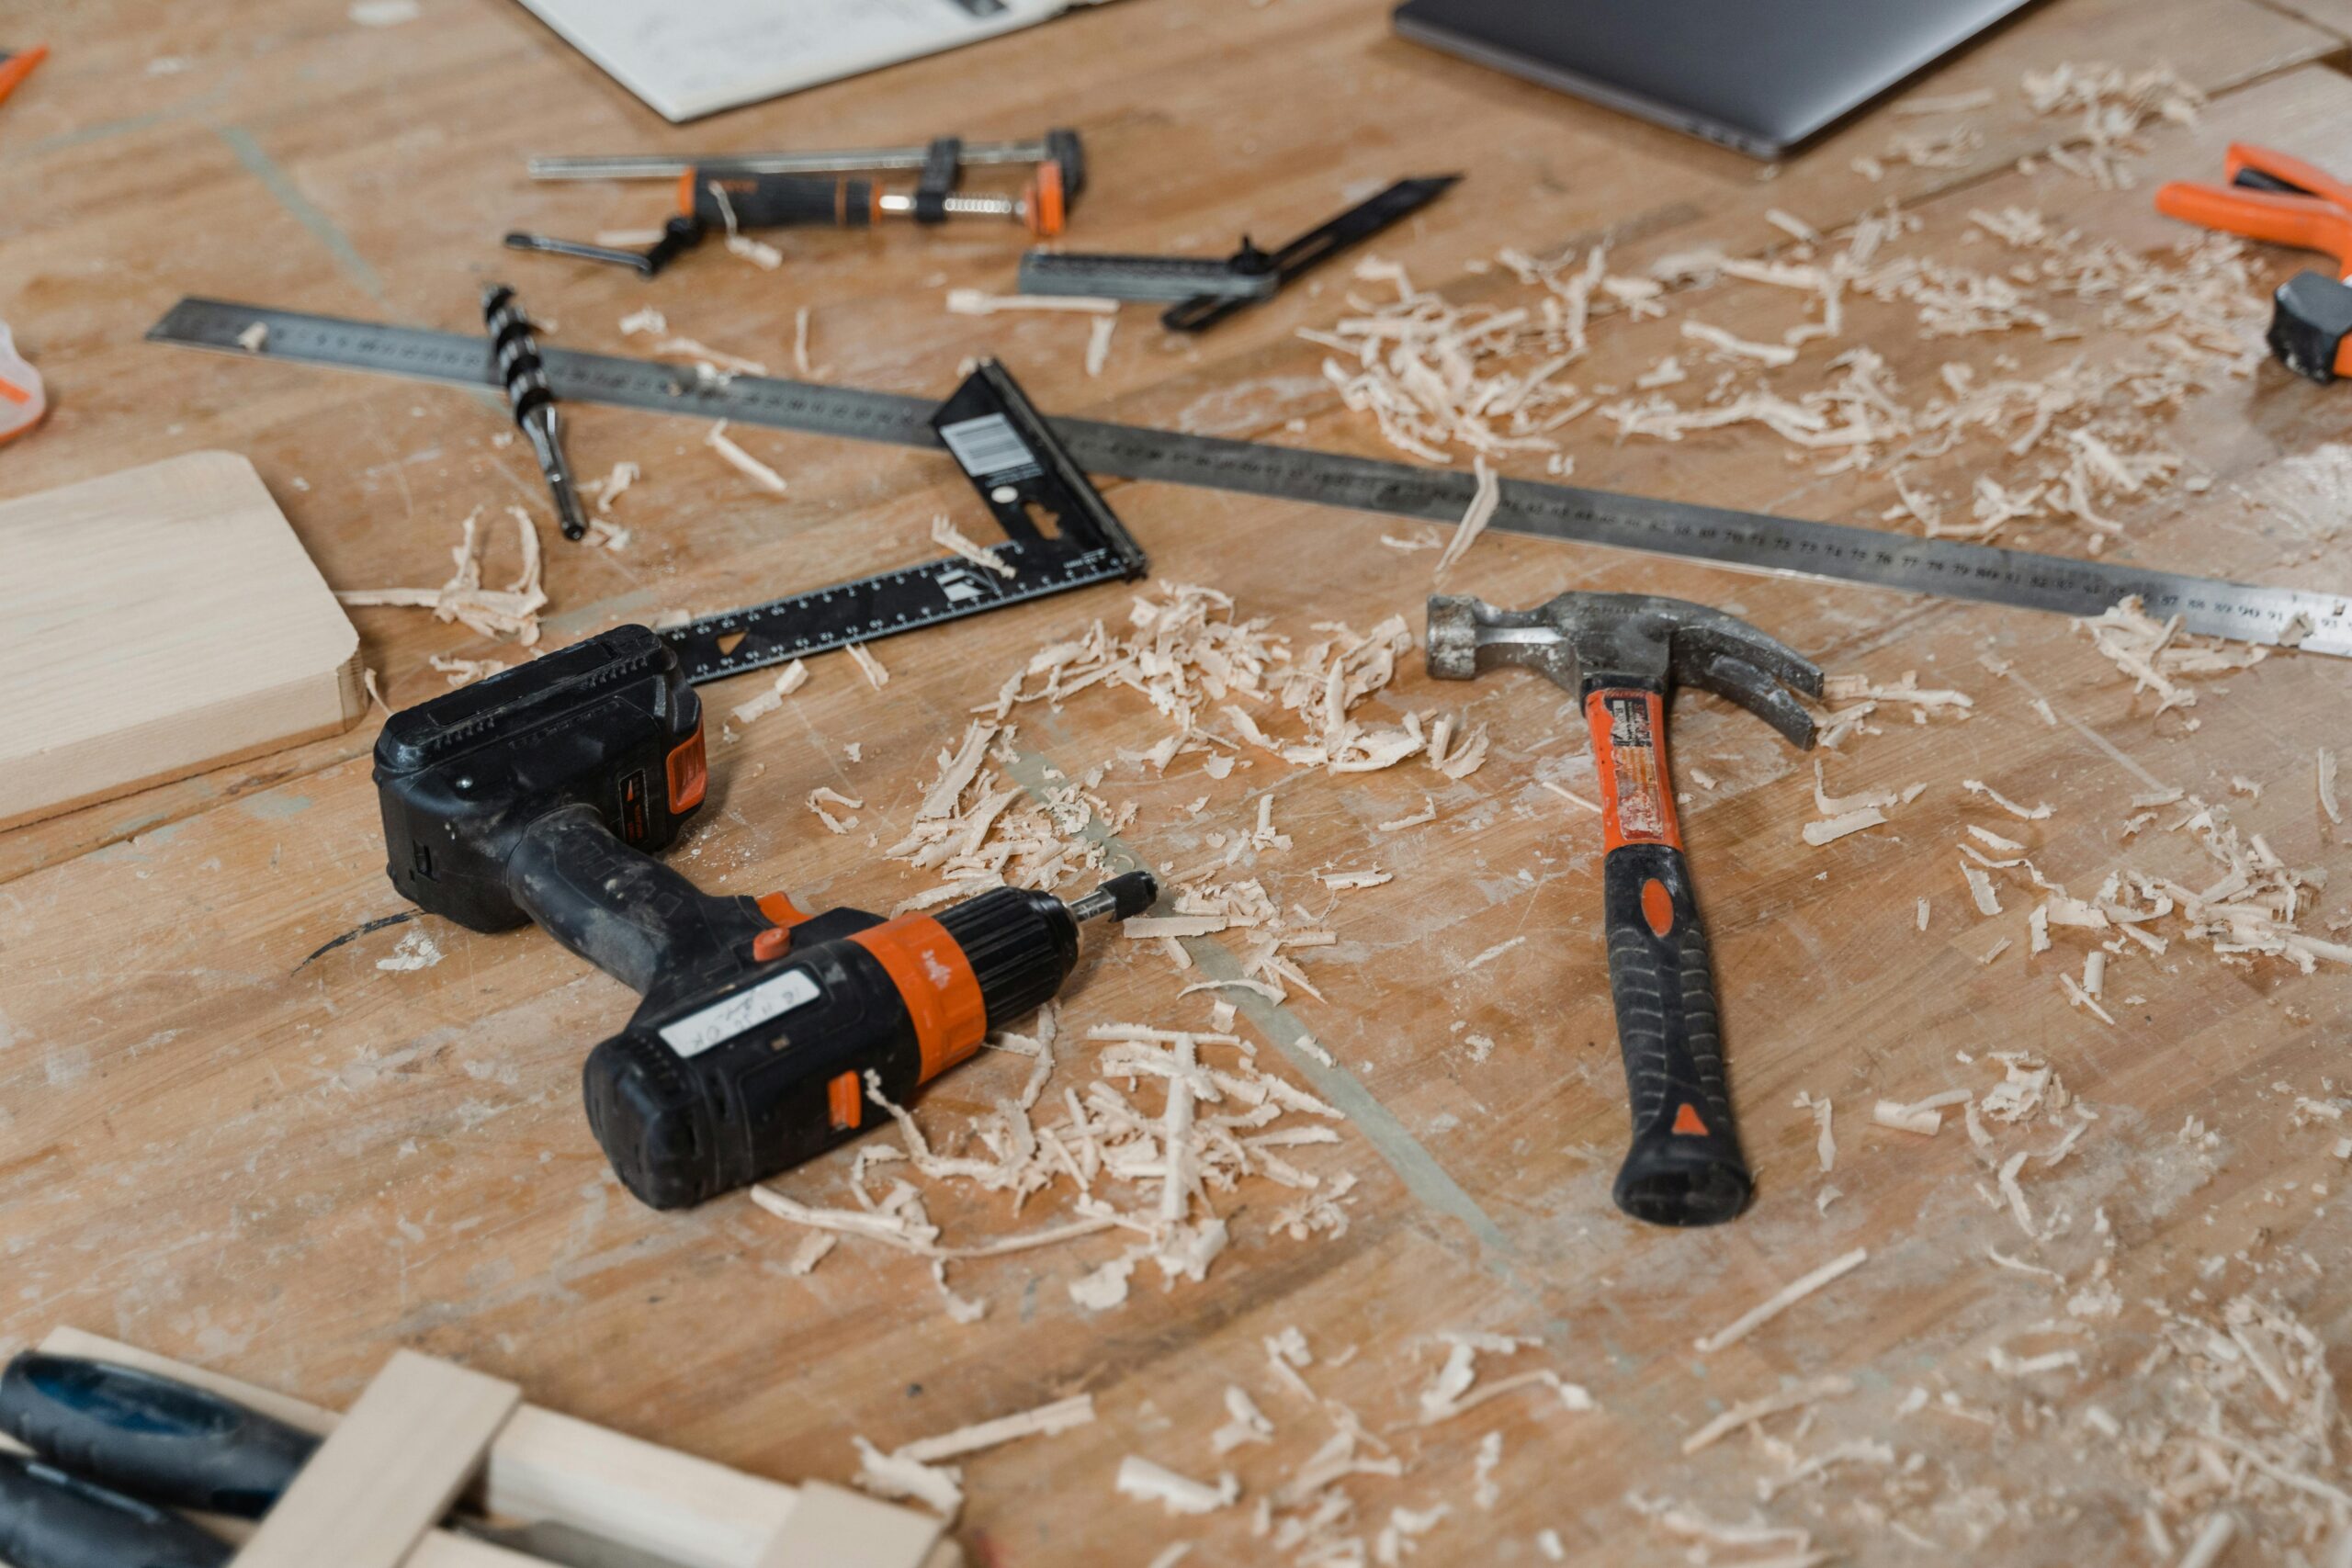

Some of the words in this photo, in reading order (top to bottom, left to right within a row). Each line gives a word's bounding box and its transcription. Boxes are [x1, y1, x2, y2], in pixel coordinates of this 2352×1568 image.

[1799, 540, 1818, 554] 73
[1850, 548, 1868, 561] 75
[1876, 551, 1893, 566] 76
[1902, 556, 1919, 569] 77
[1953, 562, 1971, 576] 79
[2238, 604, 2261, 619] 90
[2267, 608, 2283, 623] 91
